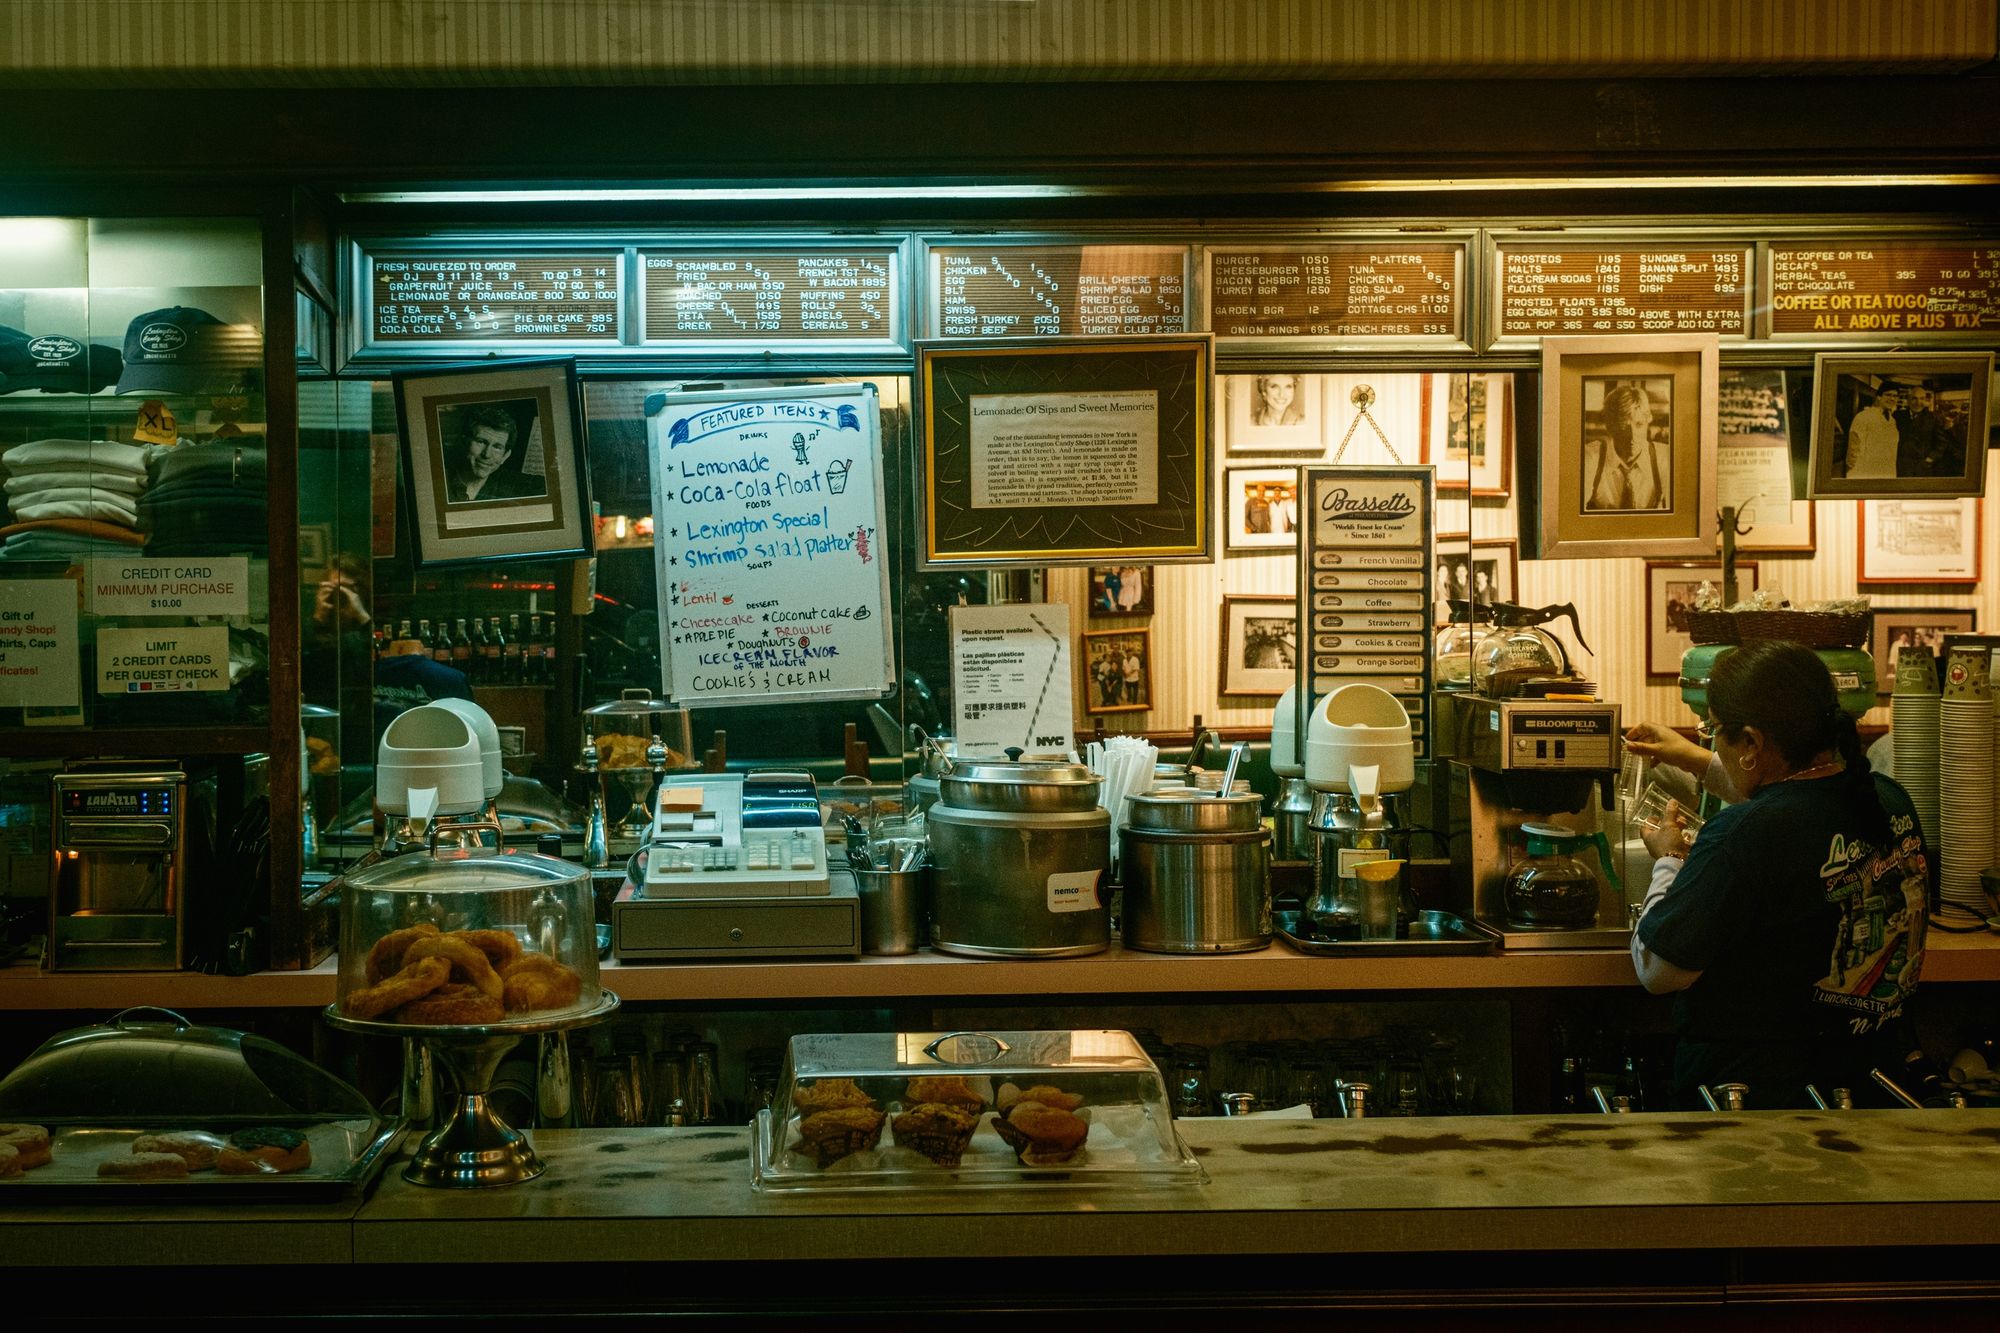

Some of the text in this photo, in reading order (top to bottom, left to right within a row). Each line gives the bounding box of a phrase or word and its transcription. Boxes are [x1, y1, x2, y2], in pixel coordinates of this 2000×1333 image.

[1216, 256, 1260, 265] BURGER
[1370, 256, 1422, 264] PLATTERS
[1508, 255, 1562, 264] FROSTEDS
[1640, 254, 1686, 263] SUNDAES
[1775, 252, 1873, 260] HOT COFFEE OR TEA
[647, 259, 673, 268] EGGS
[798, 259, 849, 267] PANCAKES
[945, 257, 971, 265] TUNA
[376, 262, 516, 271] FRESH SQUEEZED TO ORDER
[676, 262, 736, 271] SCRAMBLED
[1215, 266, 1298, 275] CHEESEBURGER
[1508, 265, 1620, 273] MALTS 1240
[1640, 264, 1708, 273] BANANA SPLIT
[1776, 262, 1818, 270] DECAFS
[799, 269, 859, 277] FRENCH TST
[945, 267, 987, 275] CHICKEN
[1775, 271, 1846, 280] HERBAL TEAS
[389, 282, 492, 291] GRAPEFRUIT JUICE
[945, 287, 965, 295] BLT
[1080, 286, 1152, 294] SHRIMP SALAD
[1507, 285, 1544, 294] FLOATS
[391, 292, 538, 300] LEMONADE OR ORANGEADE
[800, 292, 845, 300] MUFFINS
[1774, 295, 1828, 310] COFFEE
[1830, 295, 1852, 309] OR
[1853, 295, 1882, 309] TEA
[379, 306, 421, 314] ICE TEA
[1215, 306, 1319, 315] GARDEN BGR 12
[1347, 305, 1417, 314] COTTAGE CHS
[380, 315, 445, 324] ICE COFFEE
[945, 316, 1020, 324] FRESH TURKEY
[1814, 314, 1980, 329] ALL ABOVE PLUS TAX
[380, 325, 441, 334] COCA COLA
[677, 321, 712, 330] GREEK
[802, 321, 849, 329] CEREALS
[945, 326, 1008, 335] ROAST BEEF
[1230, 326, 1300, 335] ONION RINGS
[974, 403, 1154, 416] Lemonade: Of Sips and Sweet Memories
[143, 412, 175, 431] XL
[701, 405, 814, 431] FEATURED ITEMS
[740, 432, 768, 440] DRINKS
[682, 451, 770, 478] Lemonade
[775, 470, 820, 496] float
[1322, 488, 1416, 511] Bassetts
[746, 500, 771, 509] FOODS
[687, 506, 828, 544] Lexington Special
[685, 547, 748, 568] Shrimp
[121, 568, 212, 579] CREDIT CARD
[98, 583, 234, 596] MINIMUM PURCHASE
[151, 599, 181, 608] $10.00
[683, 592, 717, 607] Lentil
[2, 611, 34, 620] Gift of
[681, 614, 755, 629] Cheesecake
[0, 625, 56, 636] andy Shop!
[774, 624, 832, 638] BROWNIE
[685, 629, 735, 643] APPLE PIE
[0, 639, 56, 649] hirts, Caps
[146, 642, 177, 651] LIMIT
[783, 646, 840, 659] FLAVOR
[113, 655, 212, 666] 2 CREDIT CARDS
[770, 659, 806, 667] MONTH
[1357, 658, 1387, 667] Orange
[0, 666, 38, 675] ficates!
[106, 669, 218, 681] PER GUEST CHECK
[777, 668, 831, 687] CREAM
[1536, 720, 1596, 728] BLOOMFIELD
[1036, 736, 1064, 746] NYC
[87, 792, 138, 805] LAVAZZA
[1872, 847, 1903, 881] Candy
[1819, 992, 1887, 1014] LUNCHEONETTE
